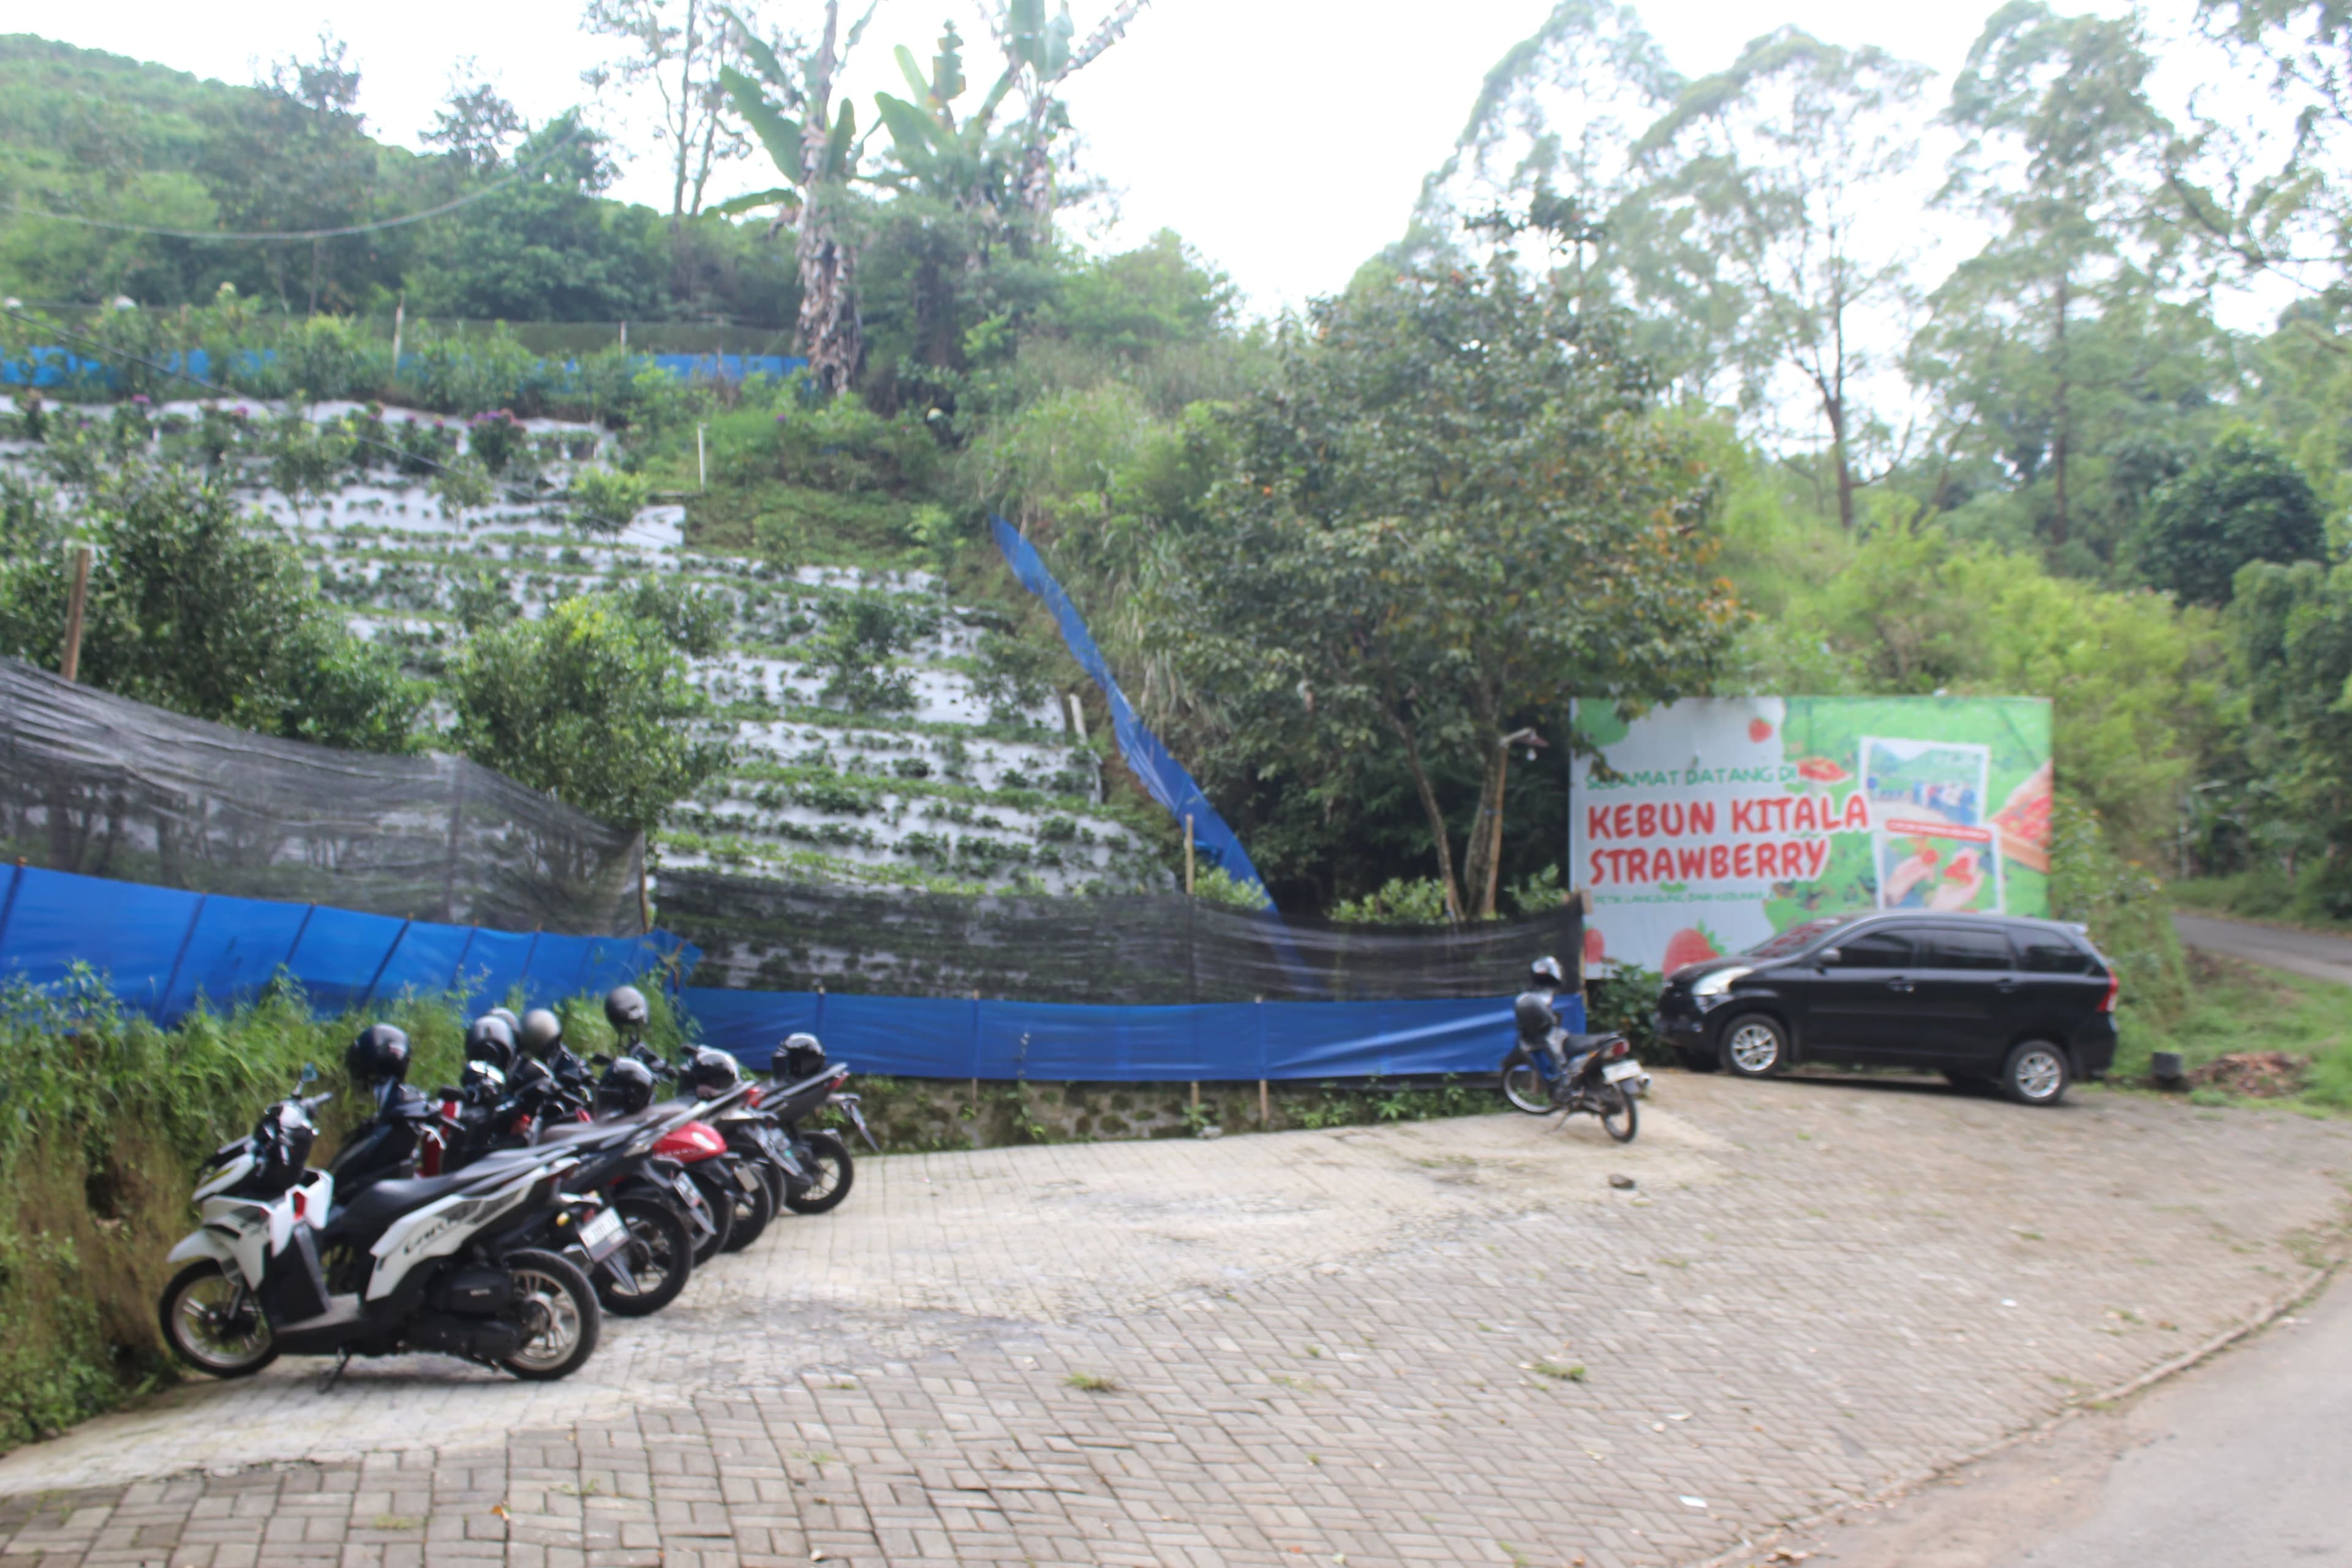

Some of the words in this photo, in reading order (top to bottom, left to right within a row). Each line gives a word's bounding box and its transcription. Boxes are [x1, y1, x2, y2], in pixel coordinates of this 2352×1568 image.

[1685, 766, 1774, 786] DATANG
[1588, 801, 1714, 840] KEBUN
[1731, 796, 1869, 834] KITALA
[1589, 838, 1827, 886] STRAWBERRY
